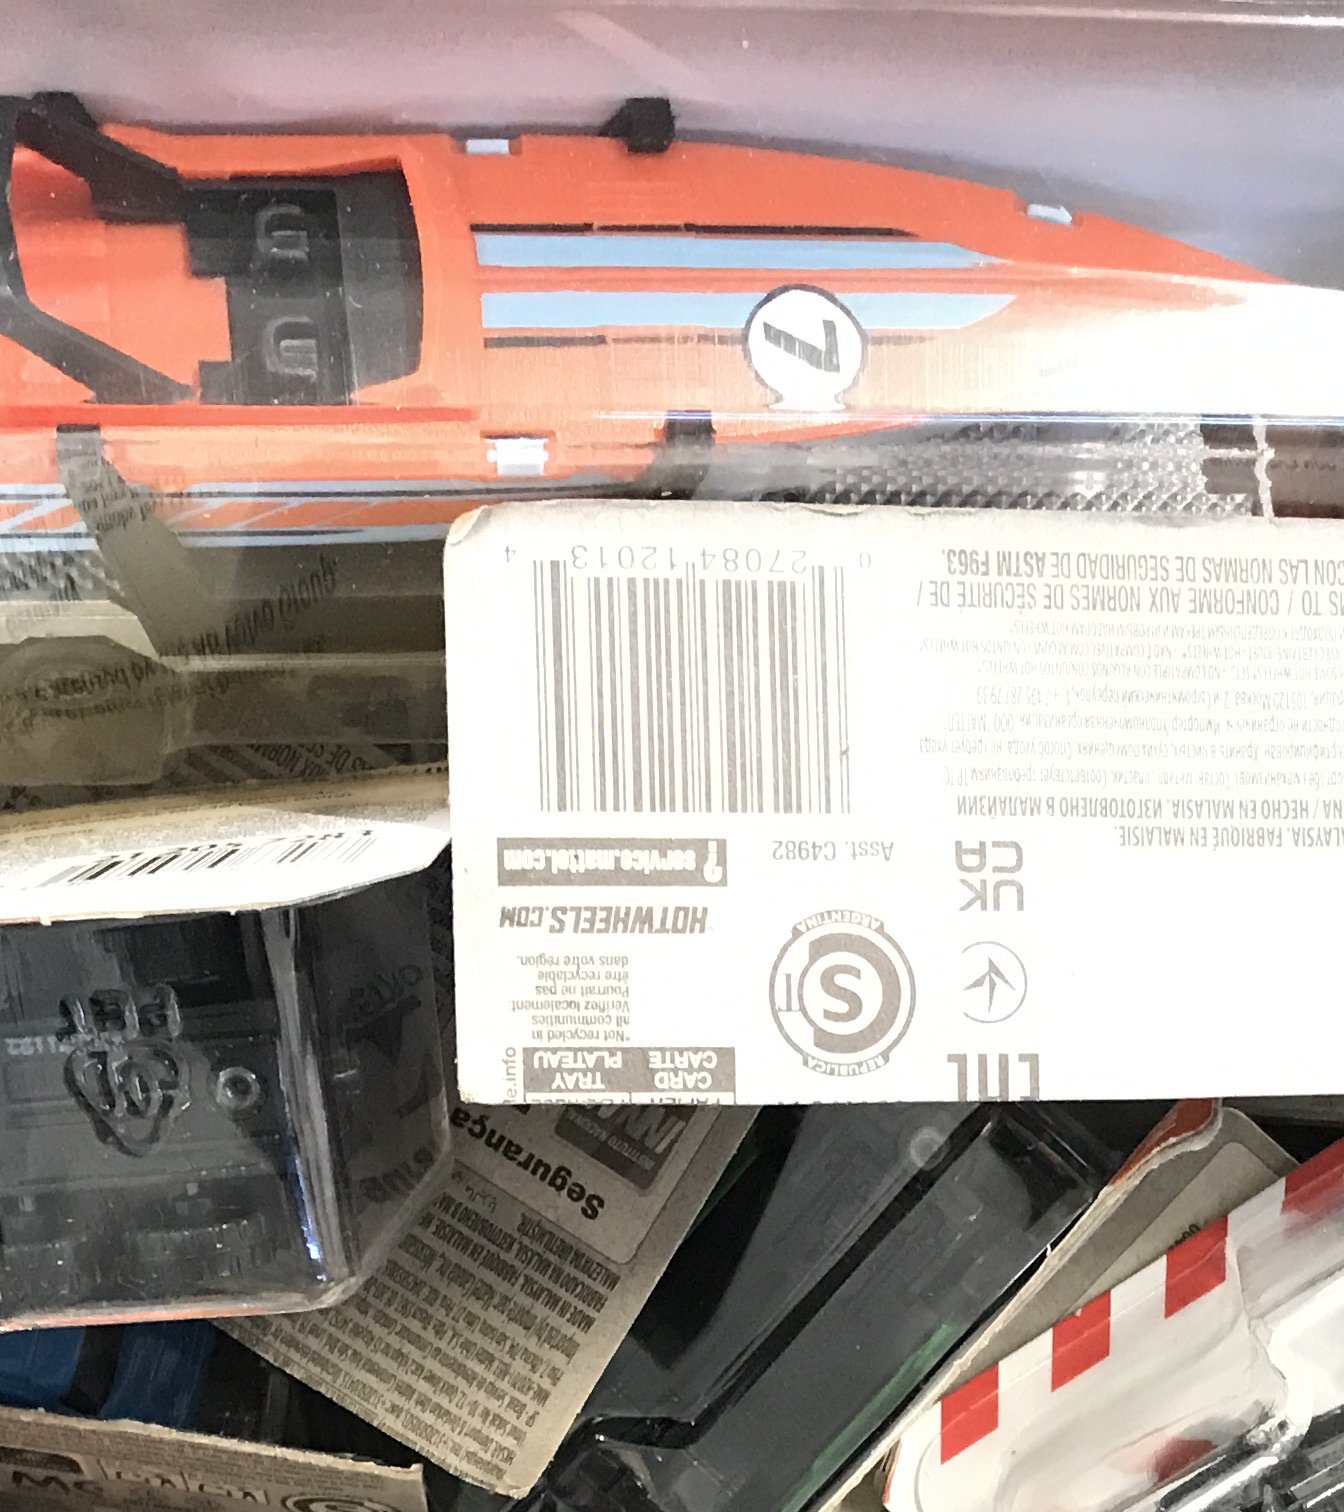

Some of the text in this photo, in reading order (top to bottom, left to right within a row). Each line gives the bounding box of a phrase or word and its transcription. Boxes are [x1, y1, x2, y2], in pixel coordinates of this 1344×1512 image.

[570, 544, 806, 572] 27084 12013
[940, 547, 989, 575] F963.
[994, 549, 1045, 577] ASTM
[1074, 551, 1171, 580] SEGURIDAD
[1173, 555, 1196, 580] DE
[1200, 556, 1272, 582] NORMAS
[1276, 557, 1308, 583] LAS
[956, 580, 1036, 614] SÉCURITÉ
[1042, 583, 1064, 609] DE
[1068, 583, 1139, 612] NORMES
[1147, 586, 1181, 612] AUX
[1187, 586, 1278, 614] CONFORME
[1301, 589, 1319, 615] TO
[955, 794, 1162, 819] ИЗГОТОВЛЕНО МАЛАЙЗИИ
[1166, 797, 1234, 817] MALASIA.
[1260, 798, 1309, 818] HECHO
[1114, 824, 1184, 846] MALAISIE.
[1212, 825, 1282, 851] FABRIQUÉ
[502, 844, 696, 874] service.mattel.com
[770, 838, 894, 862] Asst. C4982
[953, 839, 1023, 873] CA
[955, 877, 1024, 912] UK
[499, 901, 709, 933] HOTWHEELS.COM
[562, 953, 629, 968] dans votre
[536, 966, 600, 982] recyclable
[555, 1027, 599, 1042] recycled
[533, 1048, 622, 1069] PLATEAU
[647, 1049, 717, 1069] CARTE
[551, 1069, 605, 1089] TRAY
[652, 1069, 713, 1088] CARD
[451, 1105, 605, 1221] Segurança
